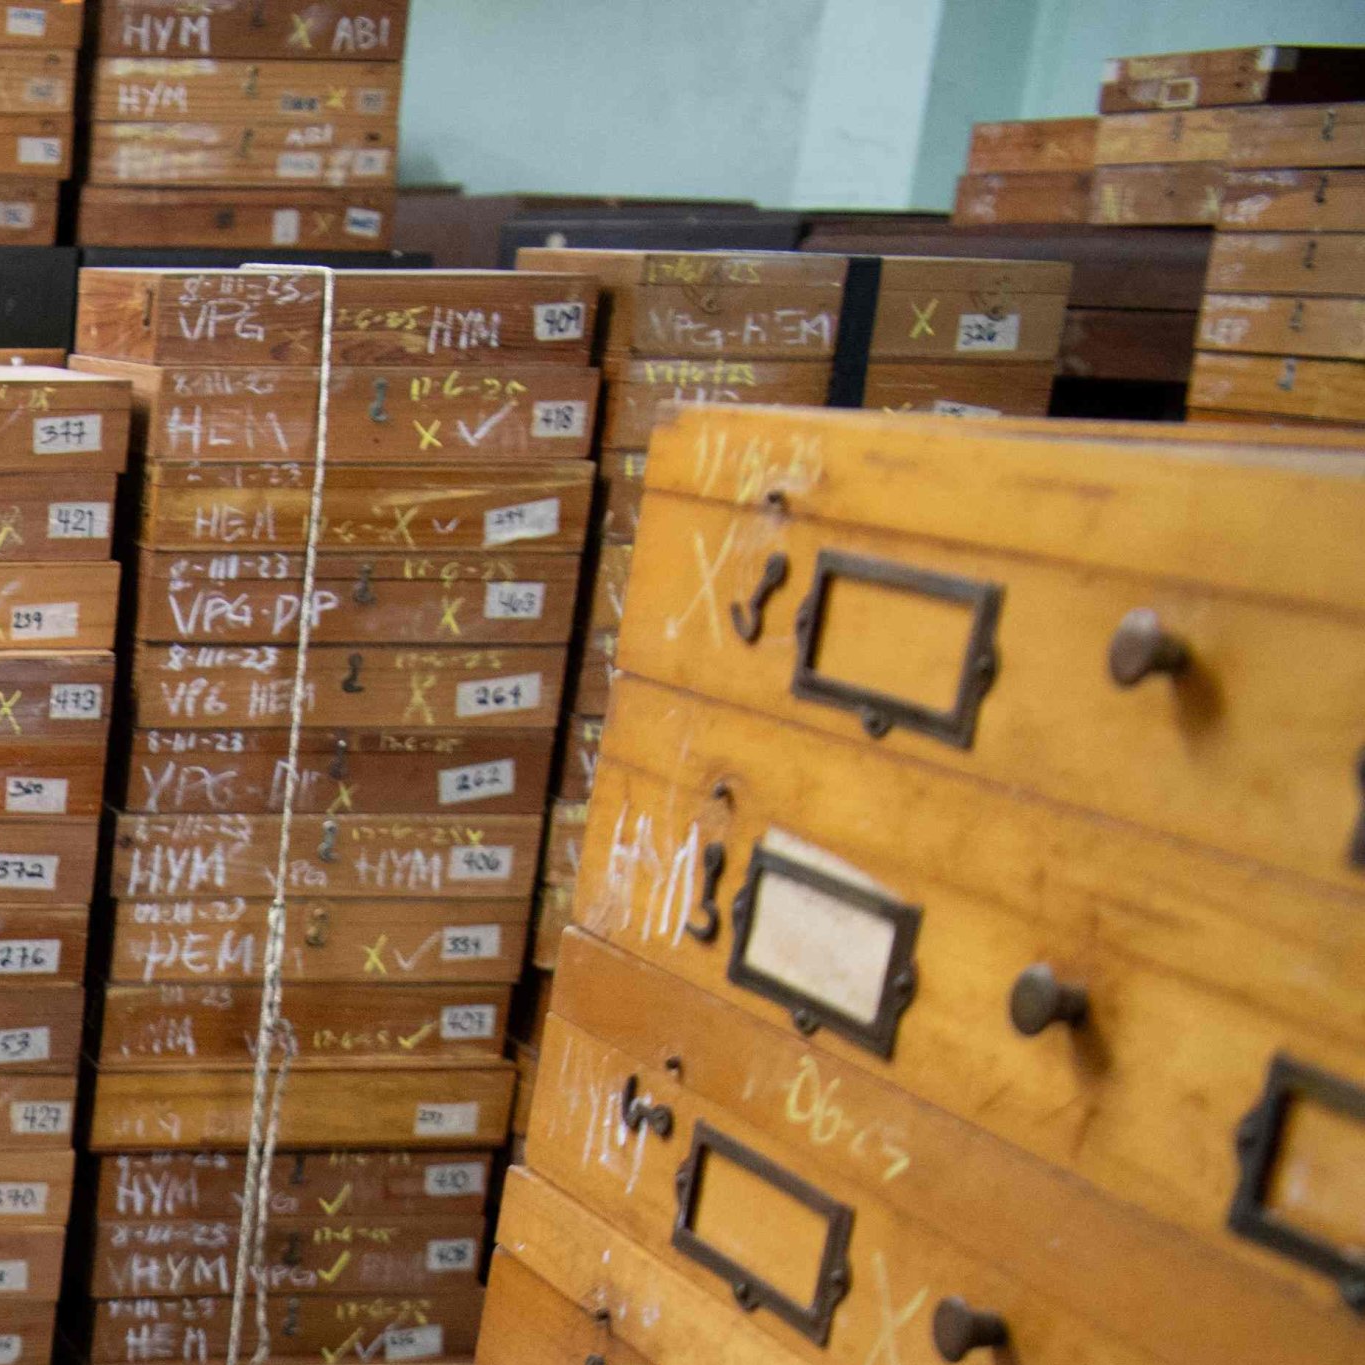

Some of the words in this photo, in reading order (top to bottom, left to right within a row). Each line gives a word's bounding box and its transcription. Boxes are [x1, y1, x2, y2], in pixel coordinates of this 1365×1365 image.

[122, 13, 212, 54] HYM
[330, 15, 392, 53] ABI
[117, 80, 189, 119] HYM
[178, 301, 265, 342] VPG
[427, 305, 502, 355] HYM
[58, 507, 96, 538] 421
[127, 843, 228, 898] HYM
[354, 846, 443, 893] HYM
[144, 930, 255, 982] HEM
[22, 1106, 62, 1131] 427
[116, 1172, 200, 1216] HYM
[130, 1252, 231, 1292] HYM
[125, 1322, 208, 1363] HEM
